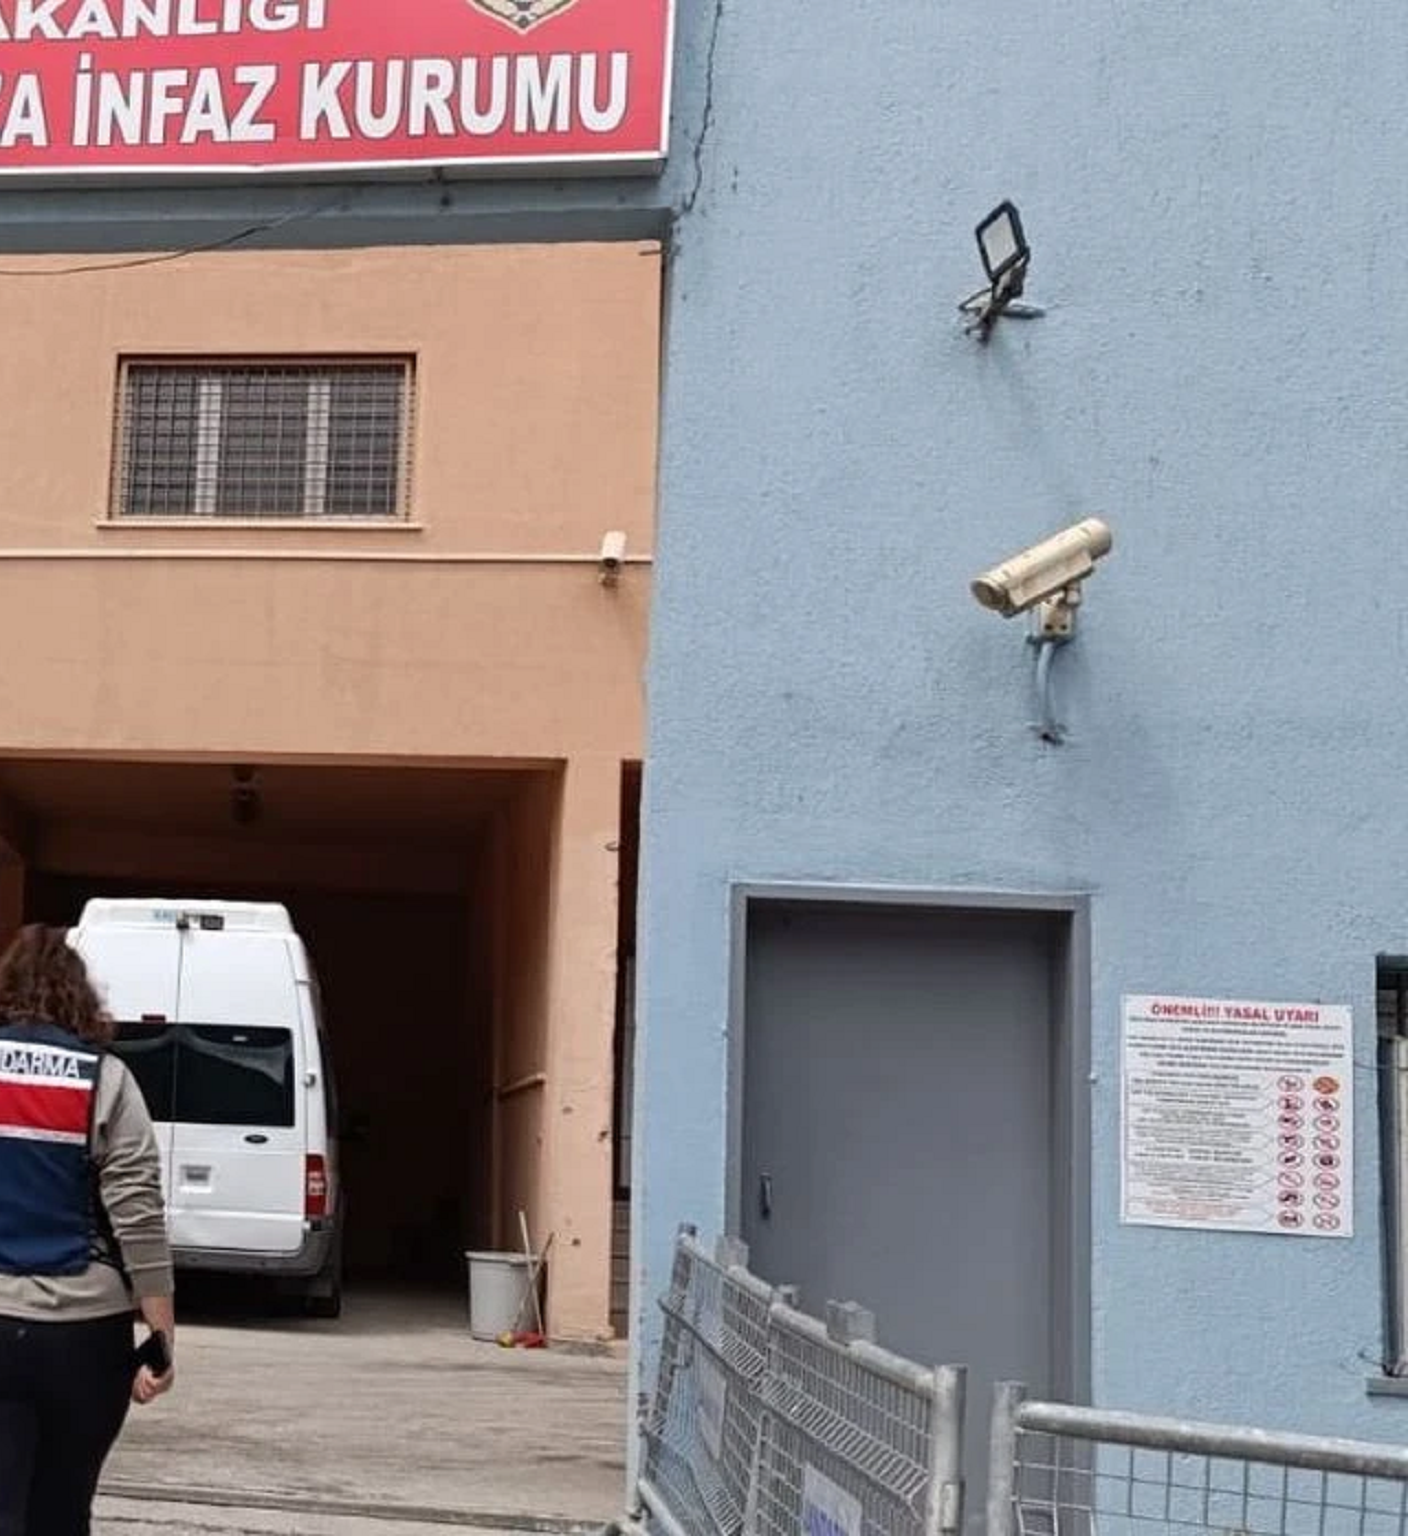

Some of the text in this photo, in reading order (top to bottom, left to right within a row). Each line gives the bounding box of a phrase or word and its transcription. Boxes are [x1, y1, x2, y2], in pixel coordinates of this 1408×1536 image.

[72, 52, 278, 147] İNFAZ
[300, 52, 629, 141] KURUMU
[1222, 1007, 1270, 1021] YASAL
[1273, 1008, 1320, 1023] UYARI
